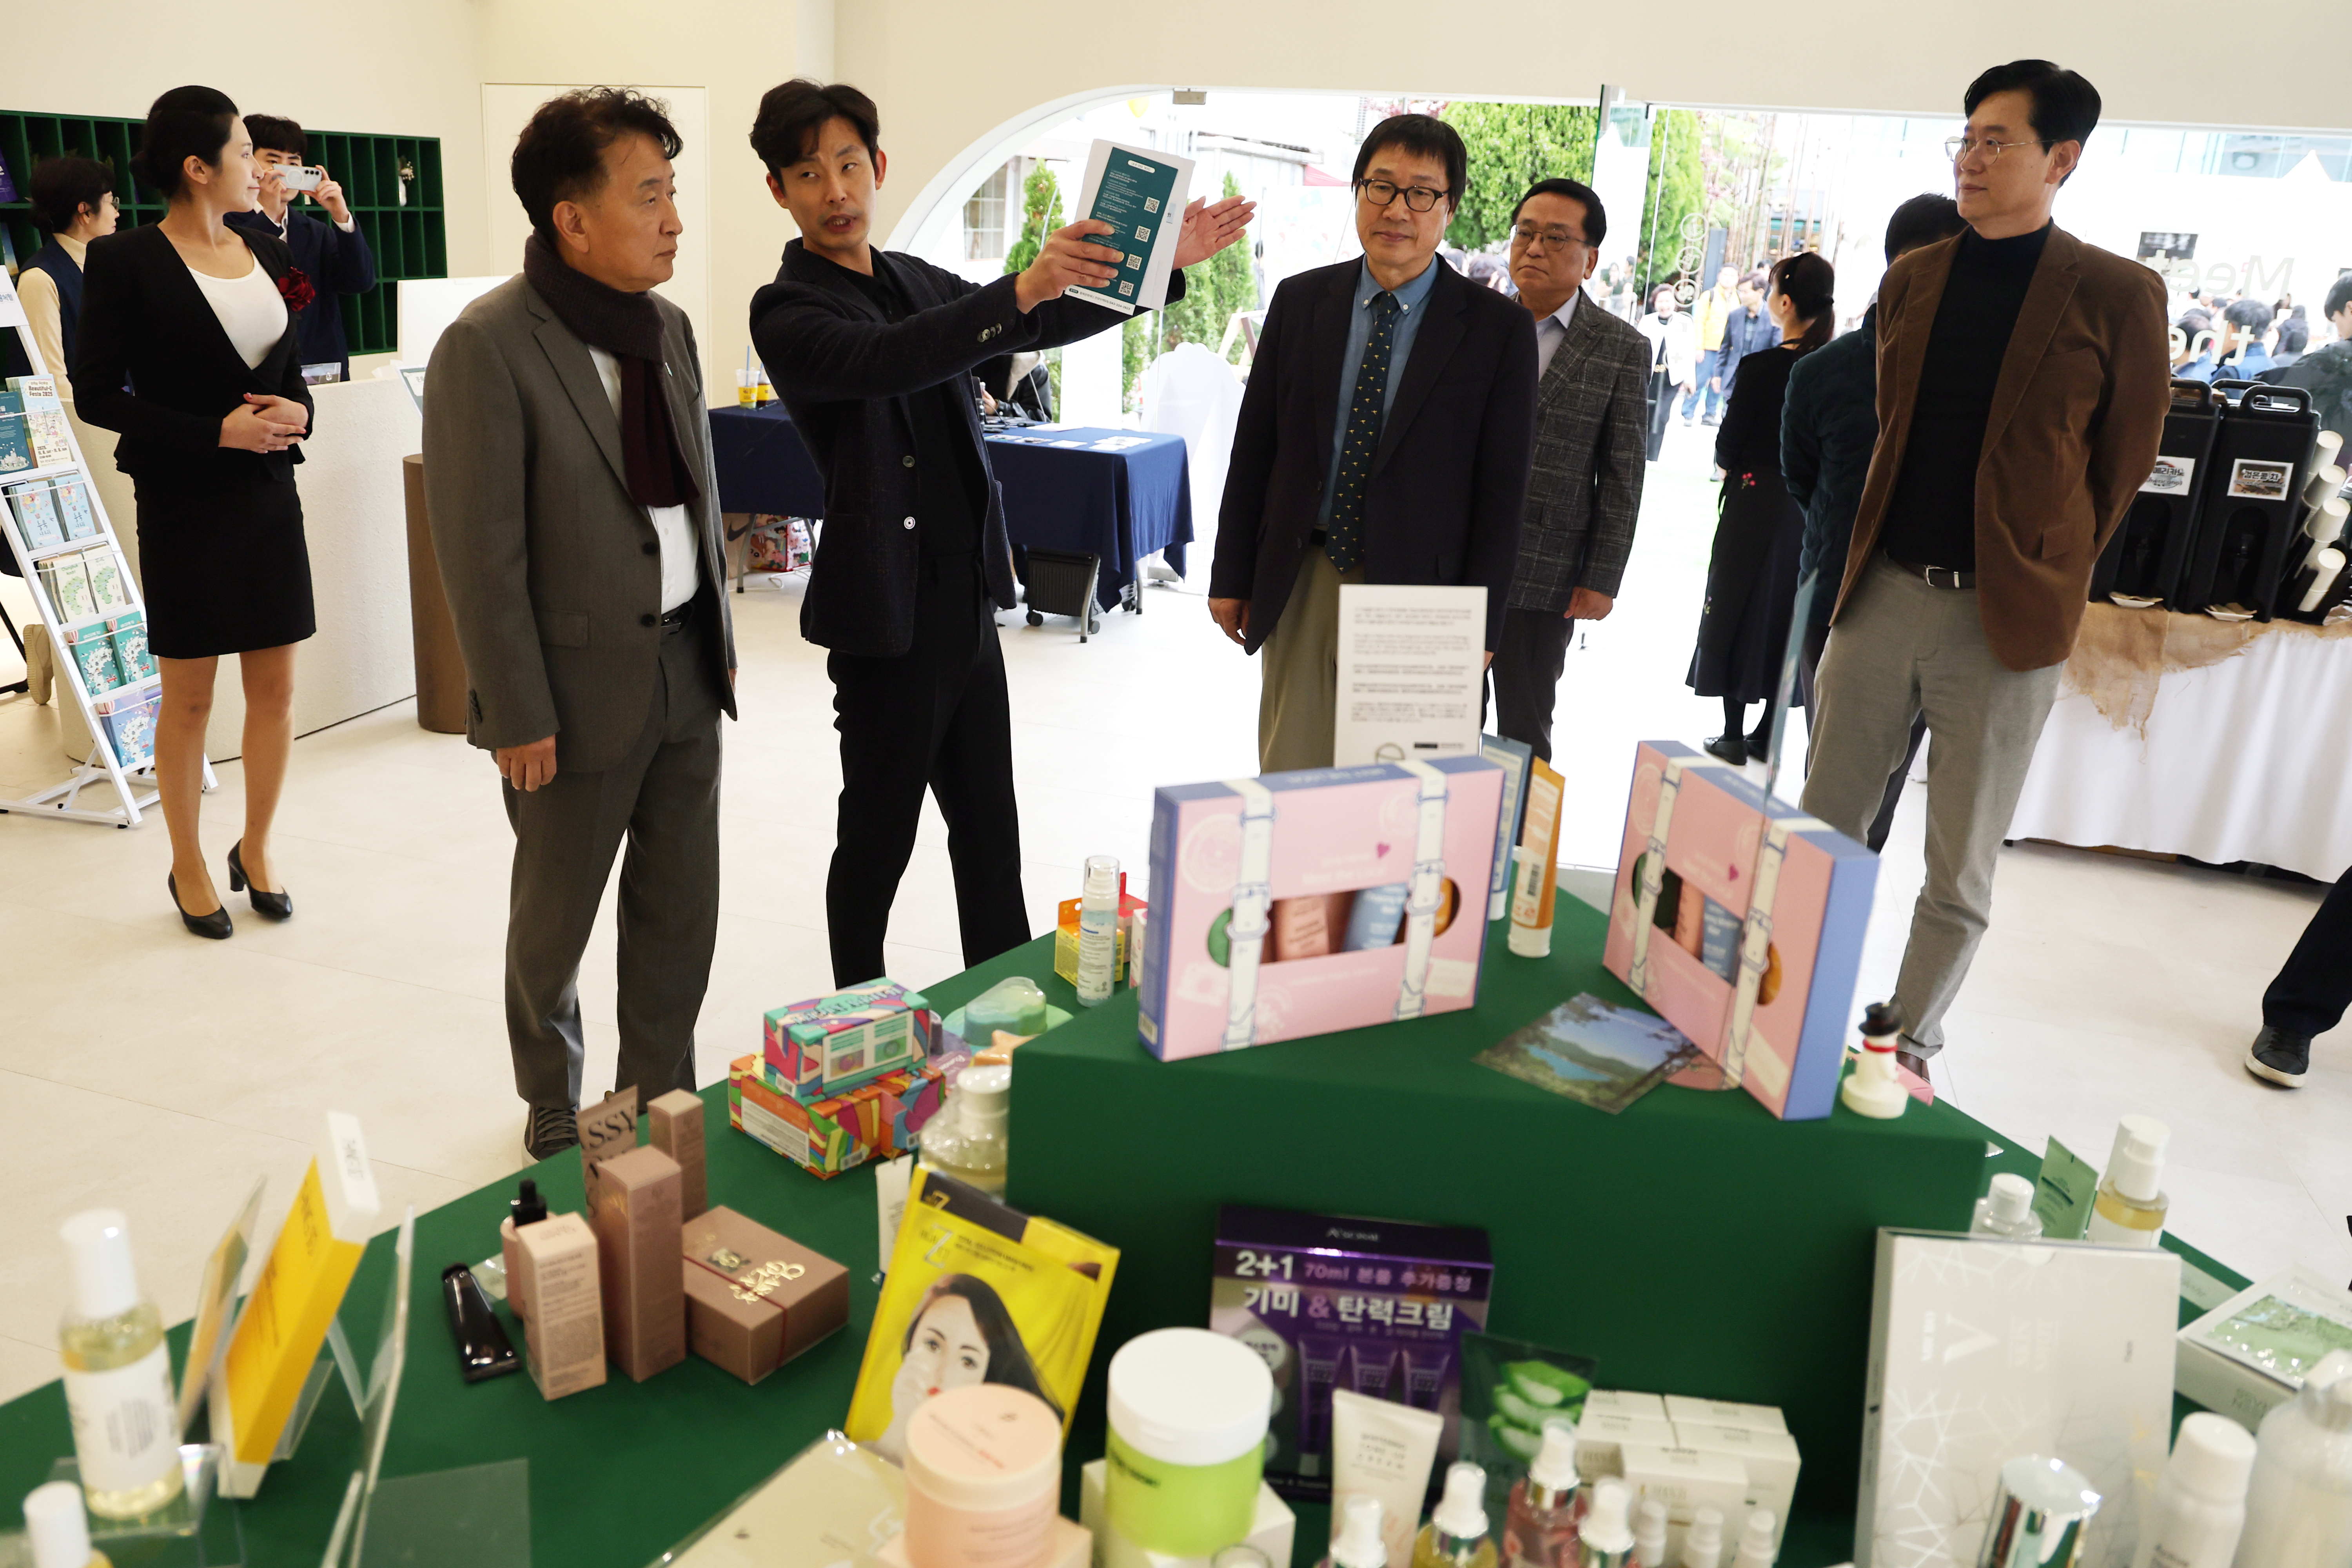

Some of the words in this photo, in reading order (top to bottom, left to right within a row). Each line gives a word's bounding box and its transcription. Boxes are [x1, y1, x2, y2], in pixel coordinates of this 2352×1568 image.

[2152, 467, 2184, 476] 메리카노
[588, 1105, 636, 1149] SSY
[1235, 1249, 1294, 1281] 2+1
[1304, 1262, 1350, 1281] 70ml
[1243, 1287, 1301, 1318] 기미
[1307, 1294, 1331, 1318] &
[1337, 1295, 1454, 1331] 탄력크림
